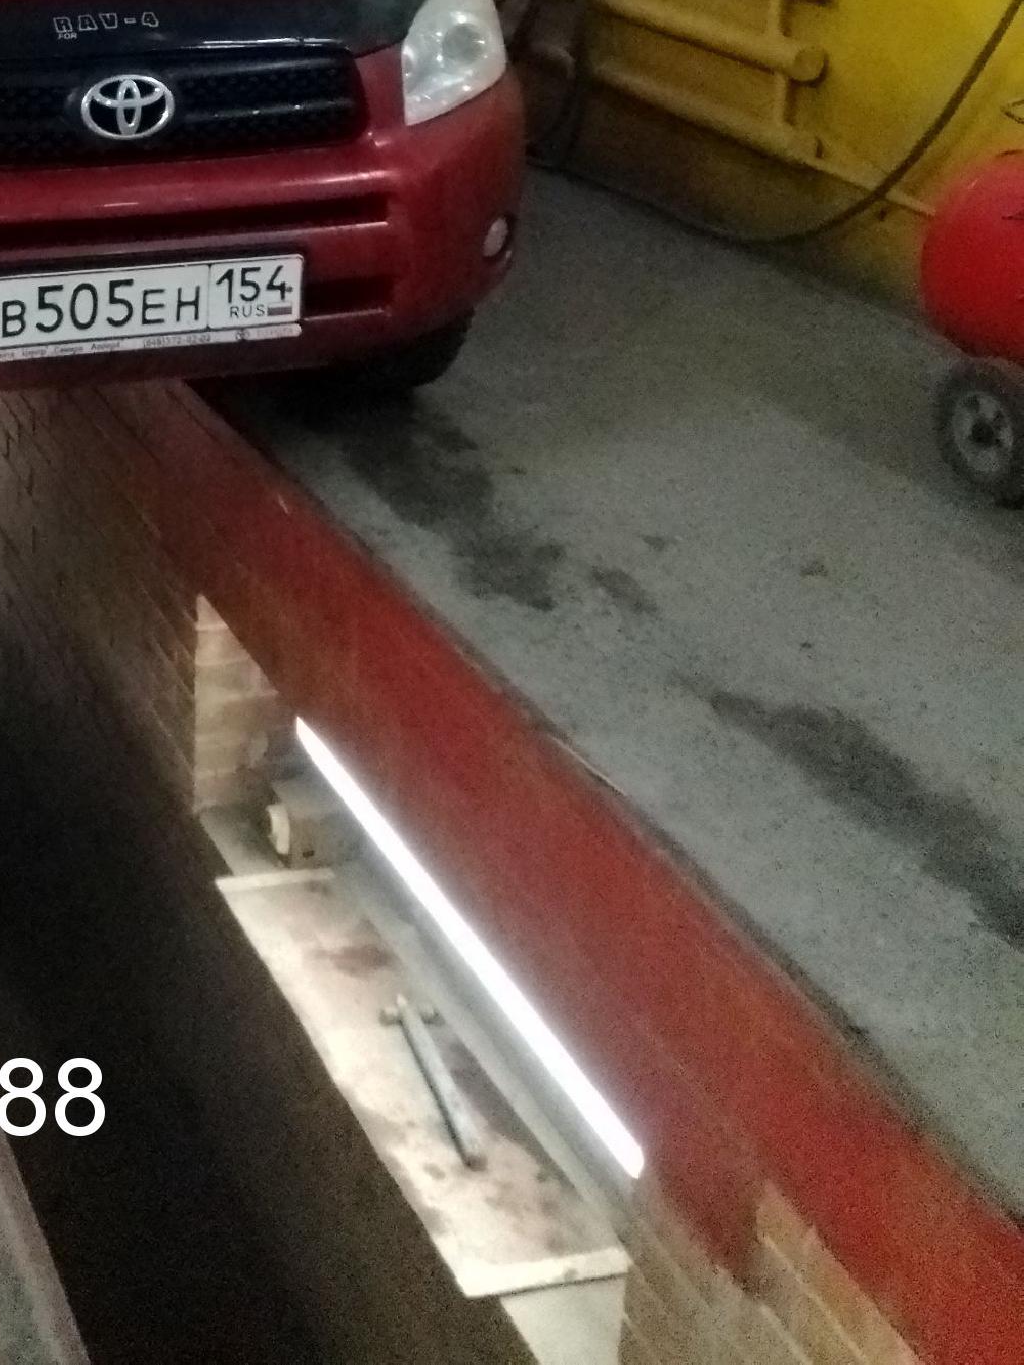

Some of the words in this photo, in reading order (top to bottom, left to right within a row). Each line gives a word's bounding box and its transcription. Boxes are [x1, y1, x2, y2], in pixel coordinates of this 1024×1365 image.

[53, 11, 160, 34] RAV-4
[1, 278, 201, 338] В505ЕН
[216, 264, 288, 303] 154
[229, 305, 267, 319] RUS
